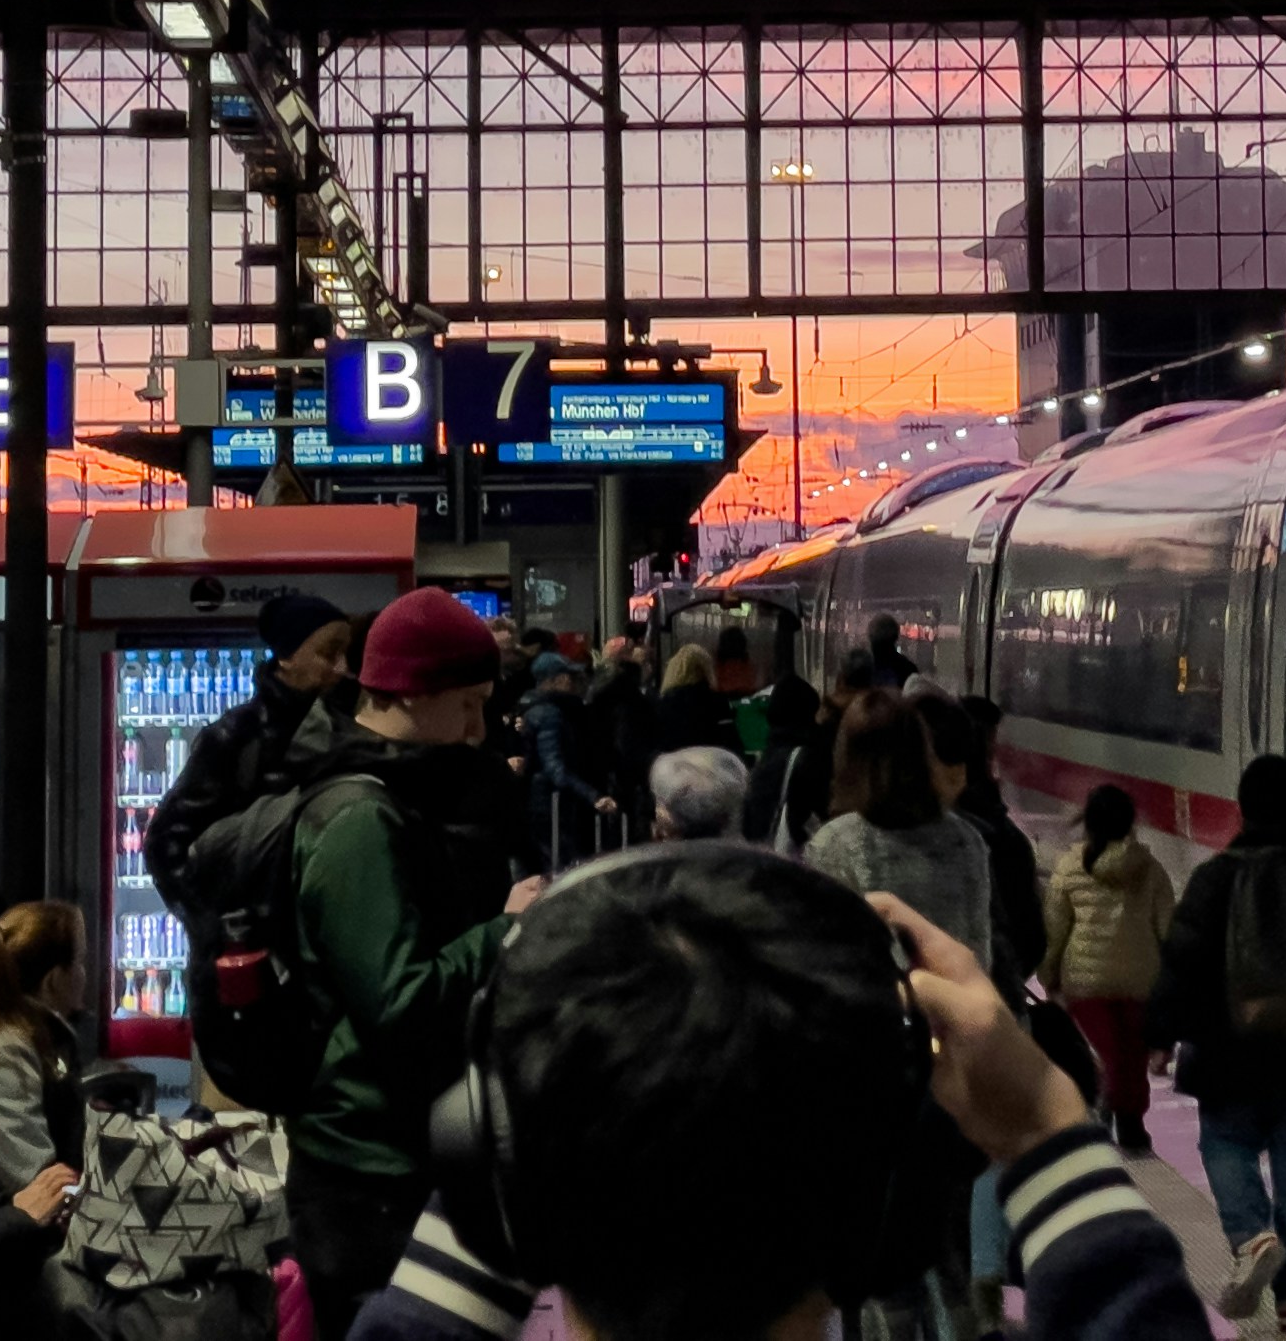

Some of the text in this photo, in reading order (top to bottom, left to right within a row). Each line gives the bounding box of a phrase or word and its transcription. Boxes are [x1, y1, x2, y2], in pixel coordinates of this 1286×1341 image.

[365, 341, 422, 420] B
[487, 341, 536, 419] 7
[561, 403, 646, 419] München Hbf
